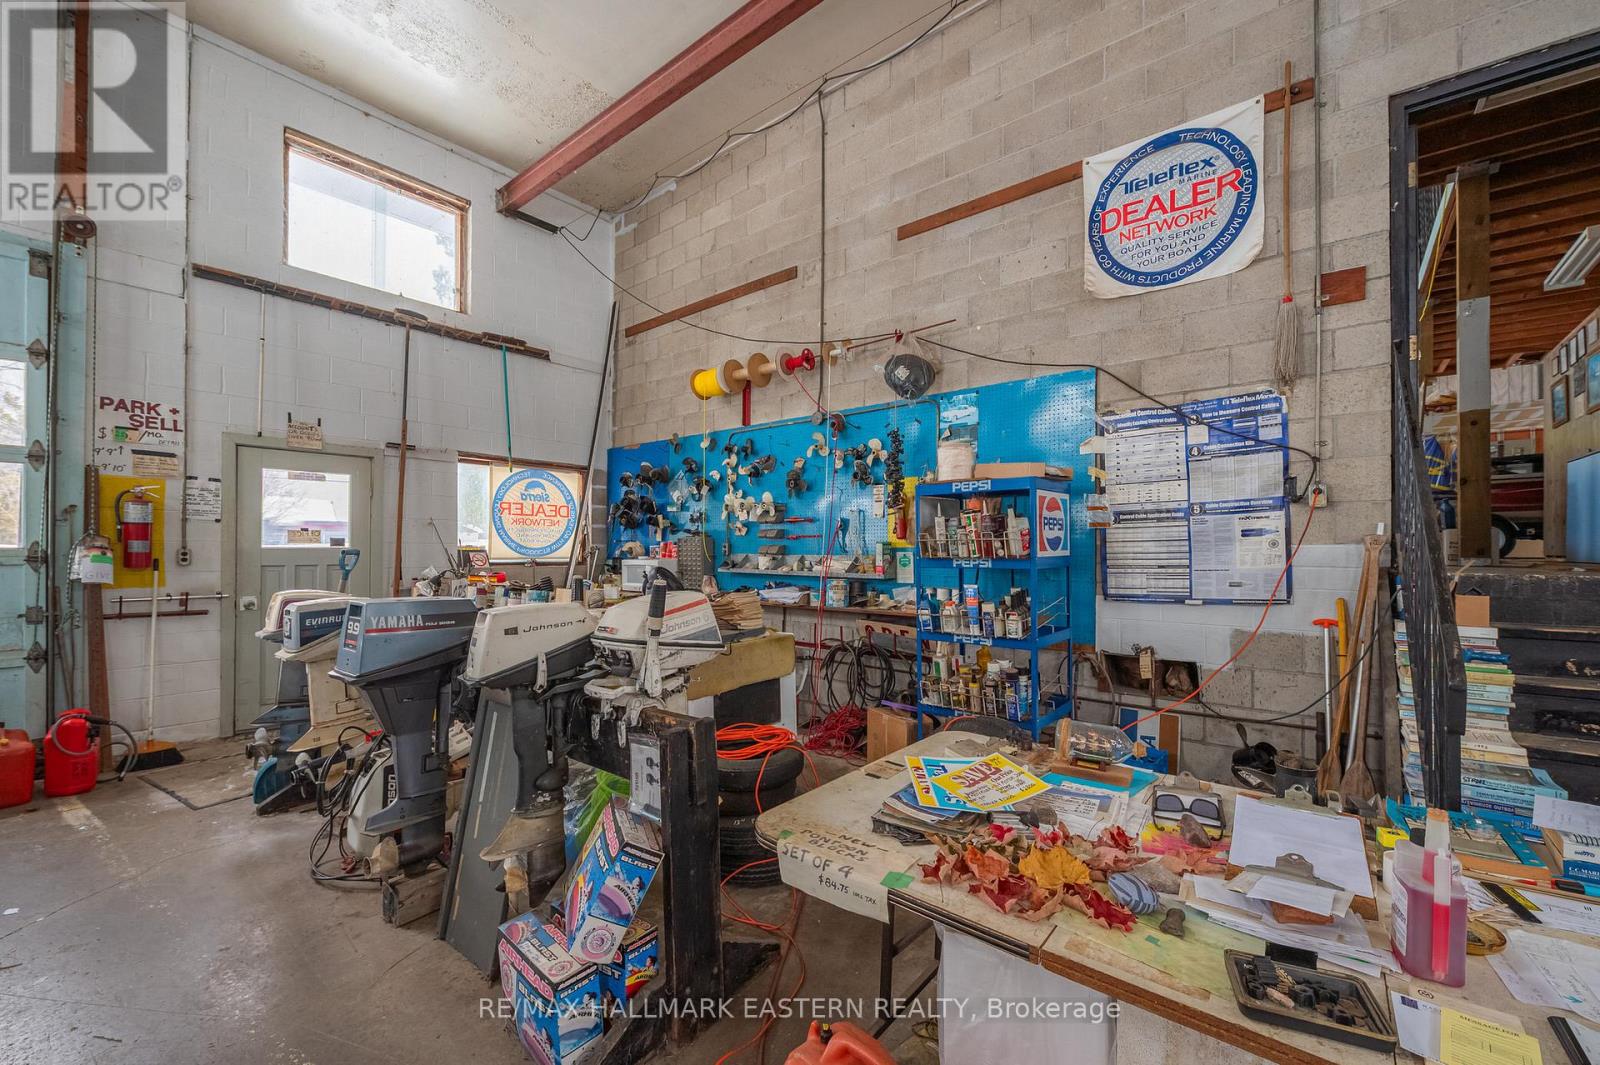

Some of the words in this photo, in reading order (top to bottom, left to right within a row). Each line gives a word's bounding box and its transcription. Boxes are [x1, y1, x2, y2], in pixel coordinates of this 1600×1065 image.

[1179, 131, 1247, 165] TECHNOLOGY
[1100, 144, 1155, 202] EXPERIENCE
[1178, 169, 1217, 185] MARINE
[1240, 163, 1253, 215] LEADING
[1101, 168, 1243, 235] DEALER
[1092, 207, 1102, 219] OF
[1119, 204, 1217, 244] NETWORK
[1090, 223, 1102, 253] YEARS
[1120, 237, 1164, 254] QUALITY
[1168, 220, 1218, 240] SERVICE
[1131, 248, 1151, 261] FOR
[1155, 242, 1177, 255] YOU
[1181, 233, 1206, 248] AND
[1203, 217, 1243, 260] MARINE
[1100, 253, 1112, 269] 60
[1137, 254, 1164, 268] YOUR
[1168, 244, 1200, 258] BOAT
[1110, 265, 1136, 283] WITH
[1137, 257, 1204, 284] PRODUCTS
[99, 396, 161, 416] PARK
[129, 414, 183, 432] SELL
[952, 479, 991, 492] PEPSI
[1193, 505, 1200, 514] 5
[1043, 516, 1063, 531] PEPSI
[953, 559, 992, 568] PEPSI
[305, 615, 343, 626] EVINRU
[370, 615, 424, 629] YAMAHA
[523, 621, 573, 633] Johnson
[661, 618, 701, 634] Johnson
[954, 634, 992, 646] PEPSI
[951, 762, 1003, 788] SAVE
[838, 834, 876, 847] NEW
[595, 838, 609, 873] BLAST
[621, 855, 655, 870] BLAST
[782, 841, 811, 863] SET
[812, 856, 833, 871] OF
[838, 865, 854, 879] 4
[818, 873, 849, 894] $84.75
[532, 938, 558, 961] BLAST
[629, 940, 657, 960] BLAST
[499, 938, 554, 1000] AIRHEAD
[560, 975, 596, 998] BLAST
